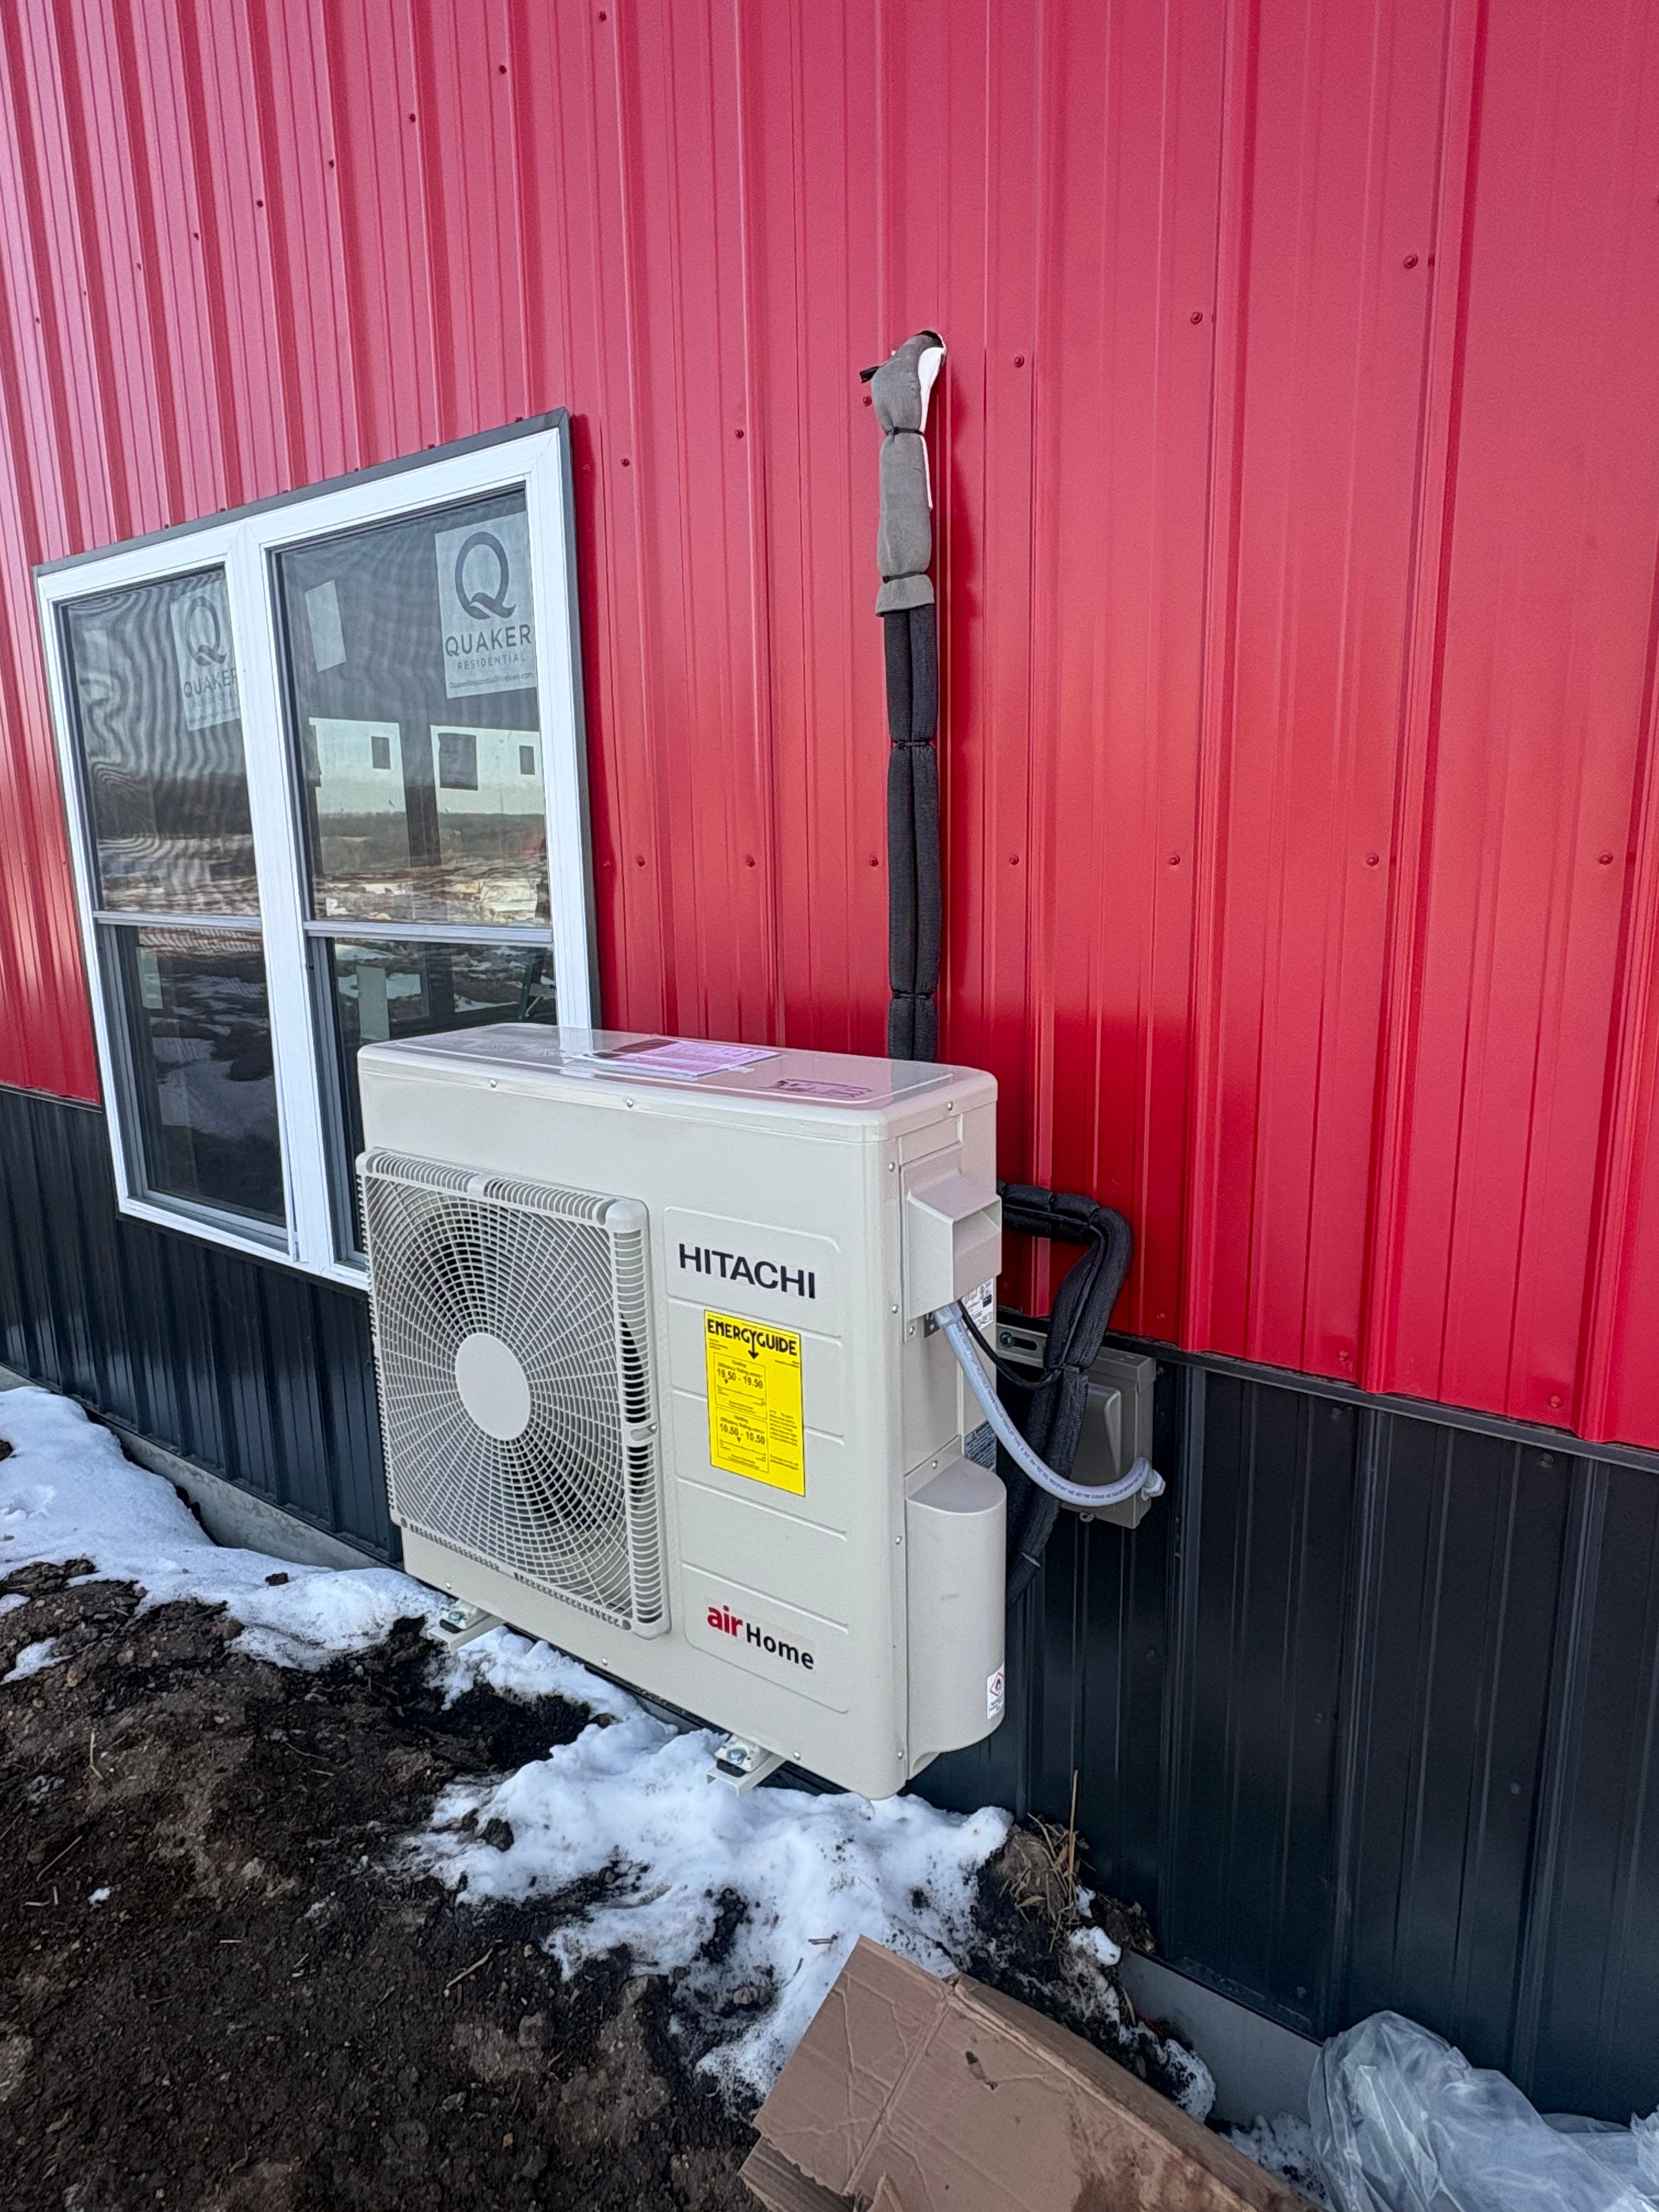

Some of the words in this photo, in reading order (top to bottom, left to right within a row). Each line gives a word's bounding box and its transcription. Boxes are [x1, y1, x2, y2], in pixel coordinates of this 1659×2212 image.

[454, 531, 517, 619] Q
[184, 595, 227, 667] Q
[445, 624, 532, 657] QUAKER
[457, 651, 526, 671] RESIDENTIAL
[679, 1243, 815, 1299] HITACHI
[707, 1318, 798, 1359] ENERGYGUIDE
[716, 1368, 736, 1381] 19.50
[743, 1375, 763, 1389] 19.50
[746, 1431, 766, 1445] 10.50
